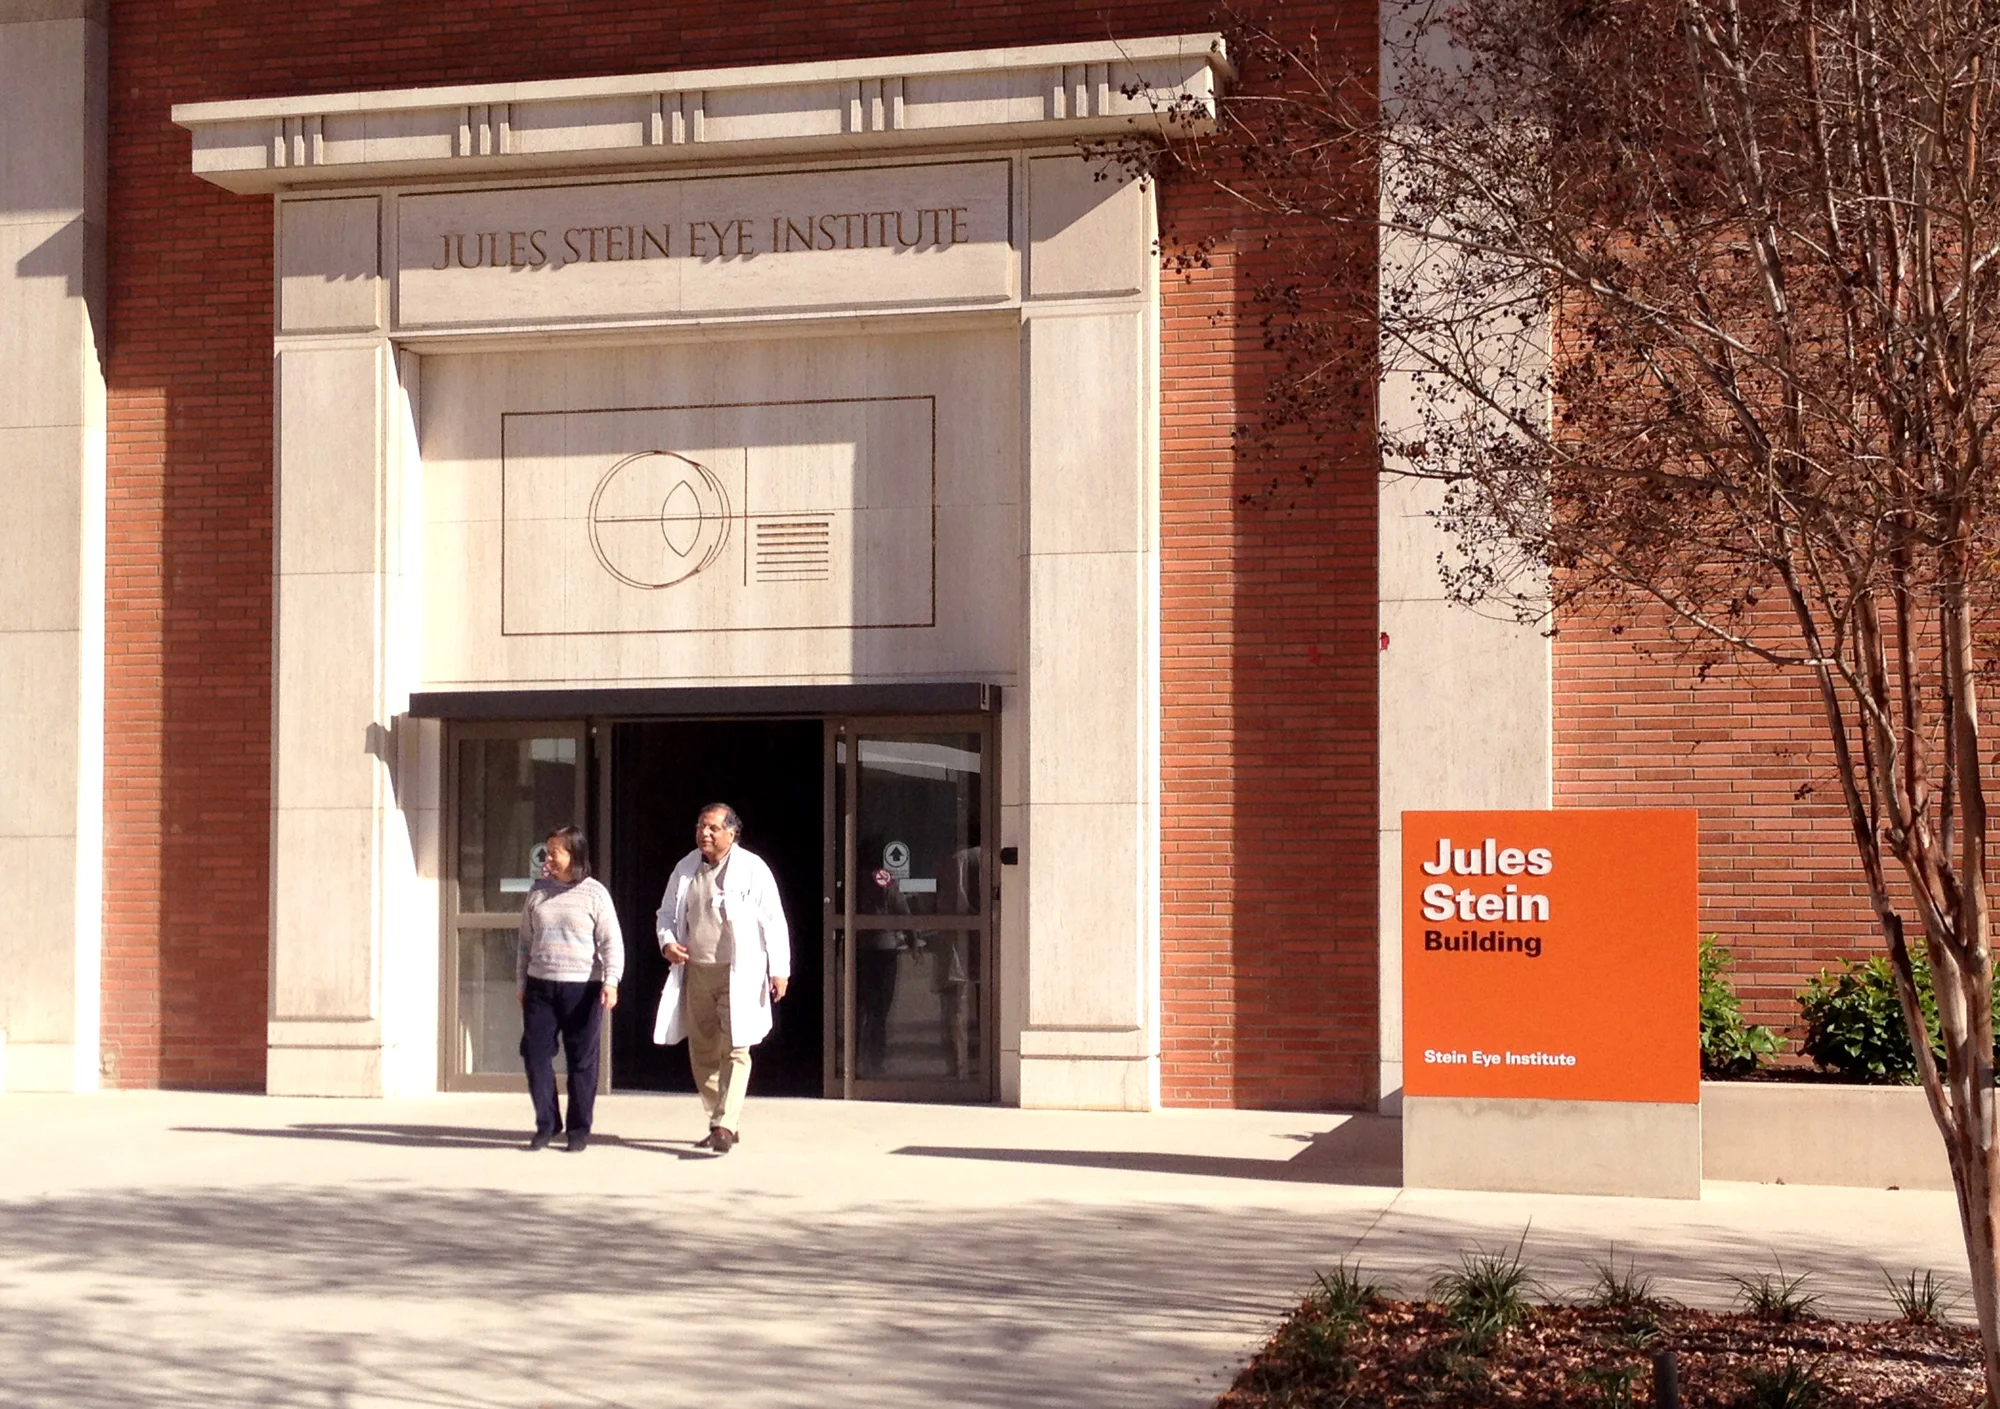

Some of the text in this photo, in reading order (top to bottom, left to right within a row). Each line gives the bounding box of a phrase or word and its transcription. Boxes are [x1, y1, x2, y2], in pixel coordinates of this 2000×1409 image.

[432, 207, 970, 270] JULES STEIN EYE INSTITUTE
[1422, 838, 1553, 875] Jules
[1422, 883, 1550, 921] Stein
[1424, 930, 1542, 957] Building
[1424, 1049, 1577, 1067] Stein Eye Institute
